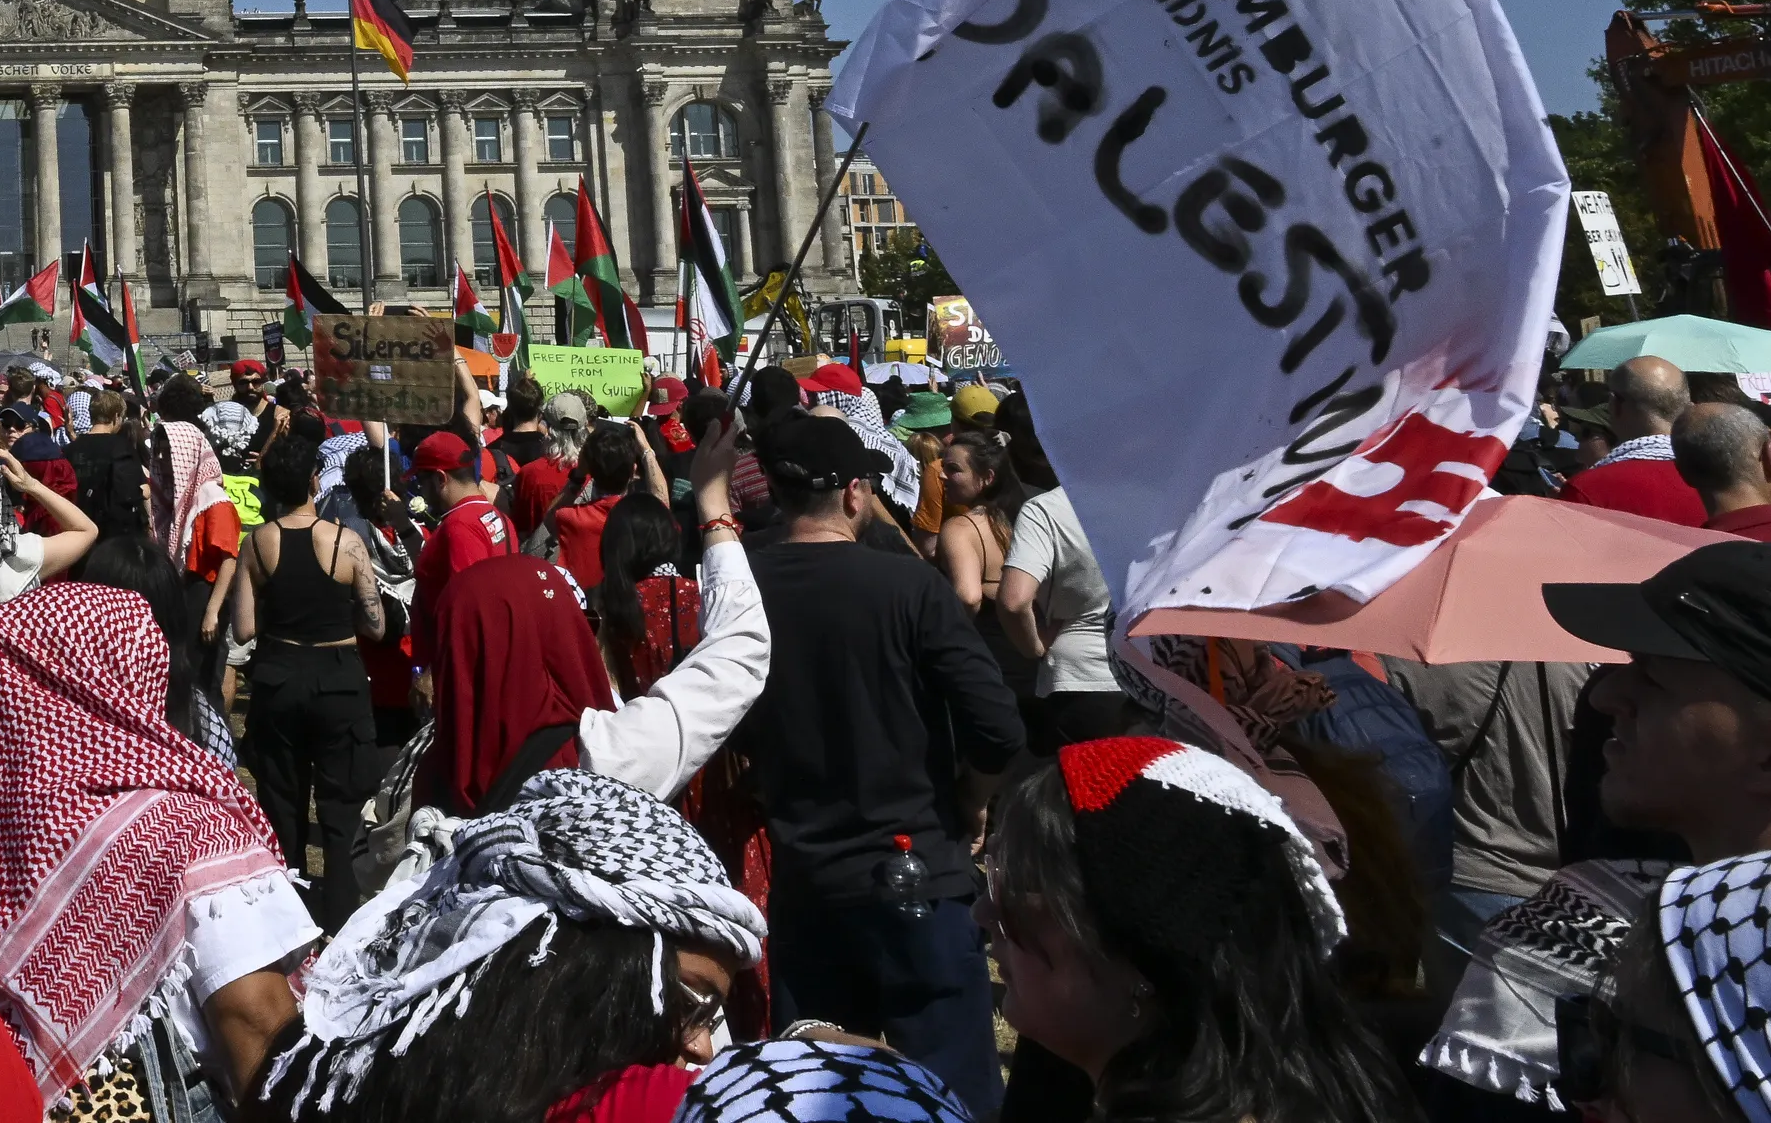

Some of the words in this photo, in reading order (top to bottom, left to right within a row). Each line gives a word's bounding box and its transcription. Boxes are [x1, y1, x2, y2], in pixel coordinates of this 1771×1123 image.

[50, 64, 92, 76] VOLKE
[948, 303, 975, 326] ST
[329, 321, 435, 360] Silence
[532, 353, 566, 363] FREE
[570, 354, 640, 365] PALESTINE
[947, 343, 1011, 369] GENO
[571, 368, 603, 377] FROM
[602, 382, 638, 398] GUILT
